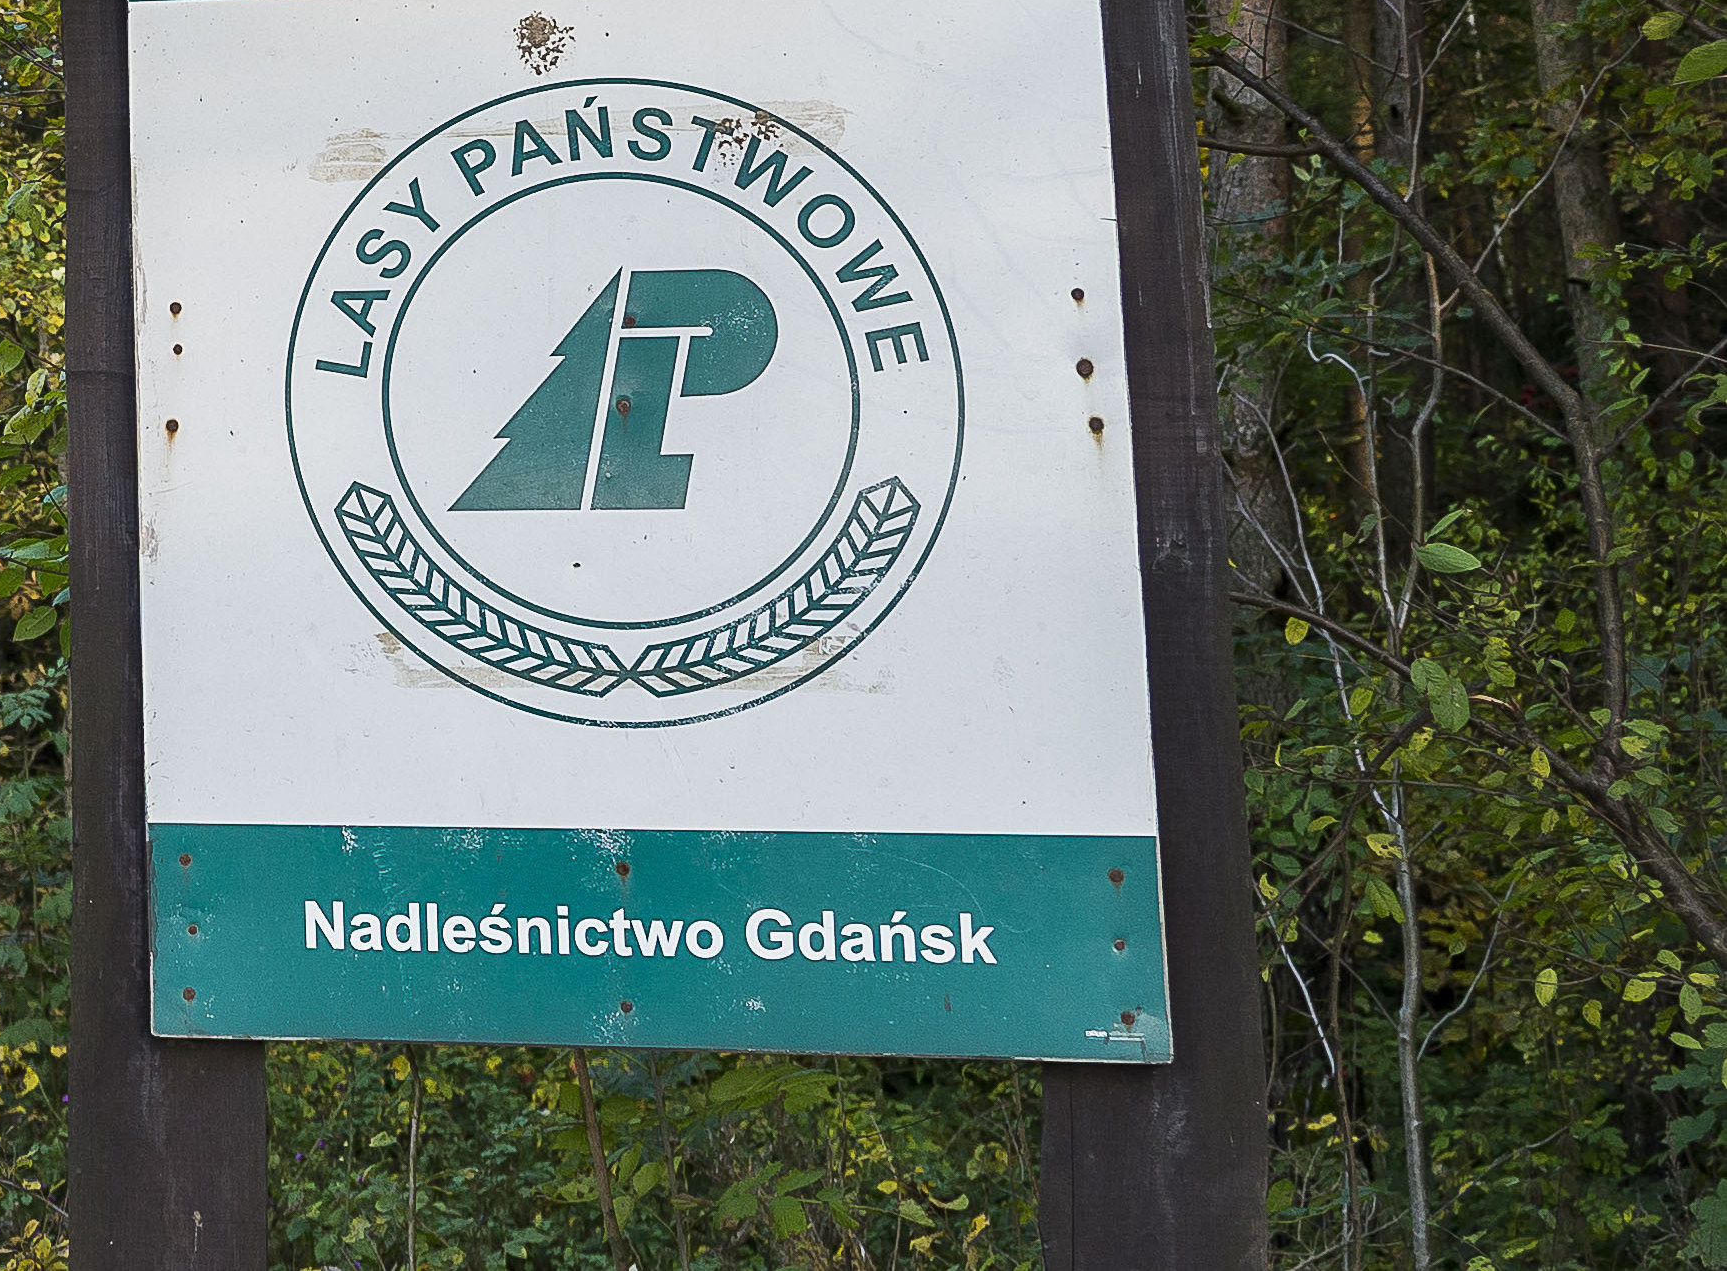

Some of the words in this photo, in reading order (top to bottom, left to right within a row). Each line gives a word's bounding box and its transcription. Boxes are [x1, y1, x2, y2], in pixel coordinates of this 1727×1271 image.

[314, 177, 441, 379] LASY
[450, 95, 930, 373] PAŃSTWOWE
[302, 898, 725, 960] Nadleśnictwo
[745, 907, 998, 966] Gdańsk
